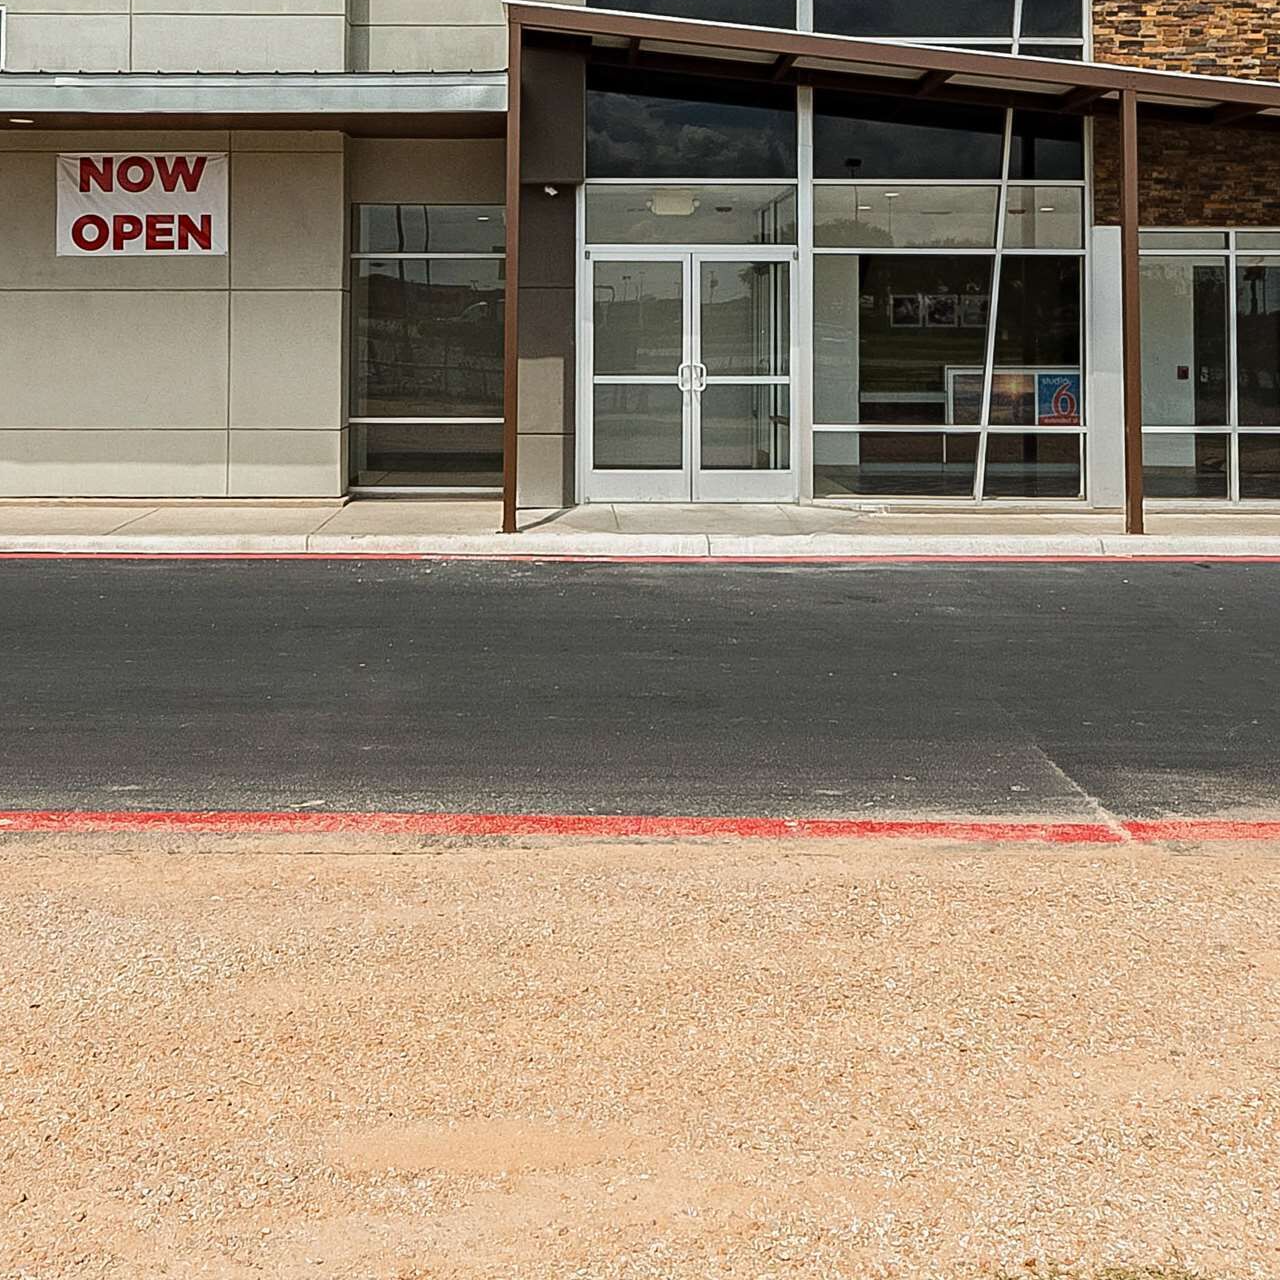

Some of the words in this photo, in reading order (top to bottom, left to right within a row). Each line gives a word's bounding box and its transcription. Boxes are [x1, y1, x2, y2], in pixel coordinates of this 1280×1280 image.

[79, 156, 208, 193] NOW
[71, 214, 212, 251] OPEN
[1052, 383, 1077, 416] 6
